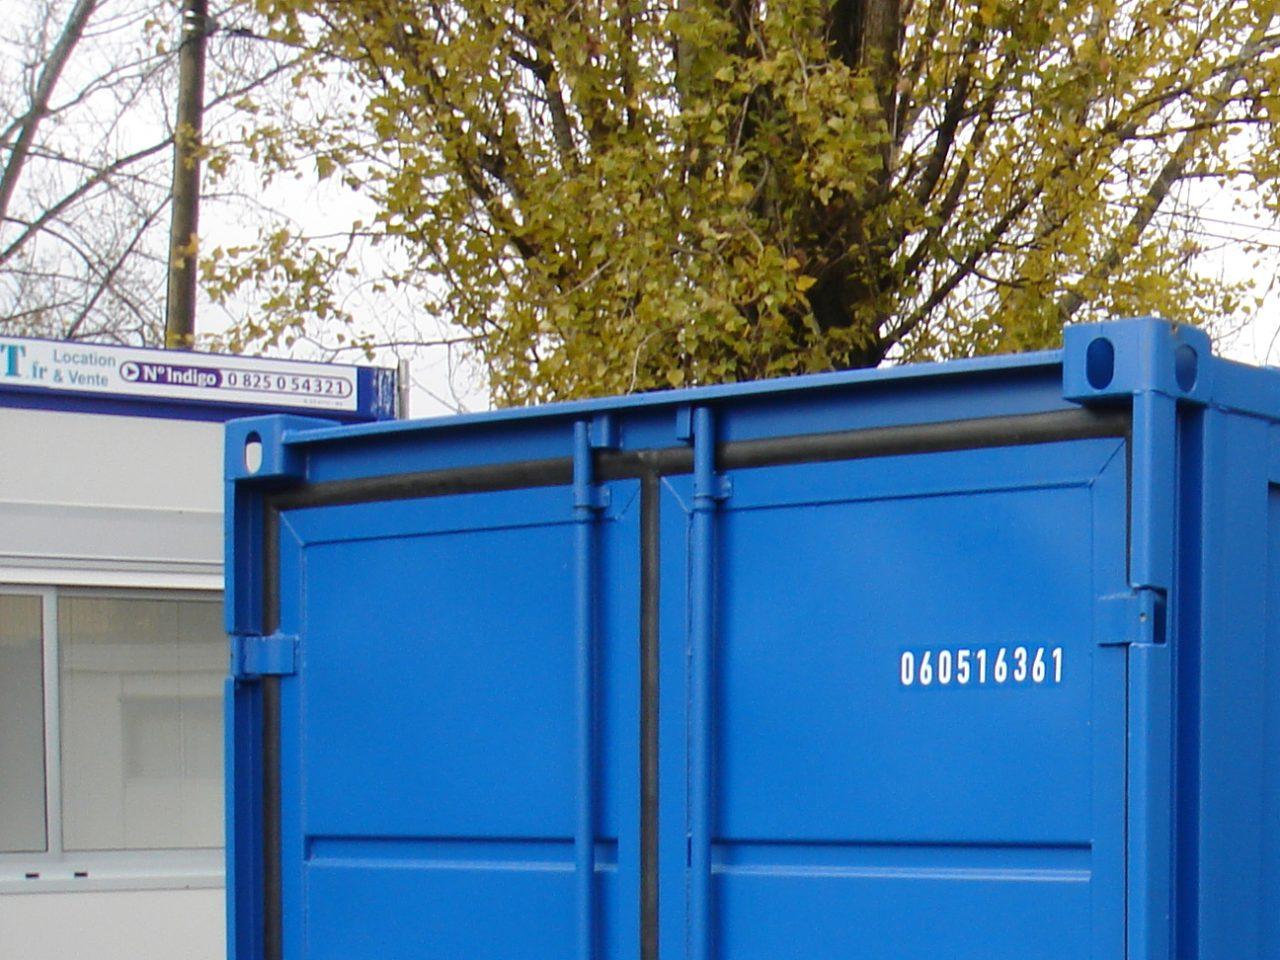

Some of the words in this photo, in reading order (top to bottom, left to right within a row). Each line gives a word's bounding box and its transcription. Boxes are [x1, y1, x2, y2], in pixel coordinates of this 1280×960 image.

[53, 349, 117, 367] Location
[53, 369, 63, 383] &
[68, 370, 109, 387] Vente
[227, 372, 238, 386] 0
[242, 373, 272, 389] 825
[276, 376, 287, 391] 0
[901, 646, 1063, 686] 060516361
